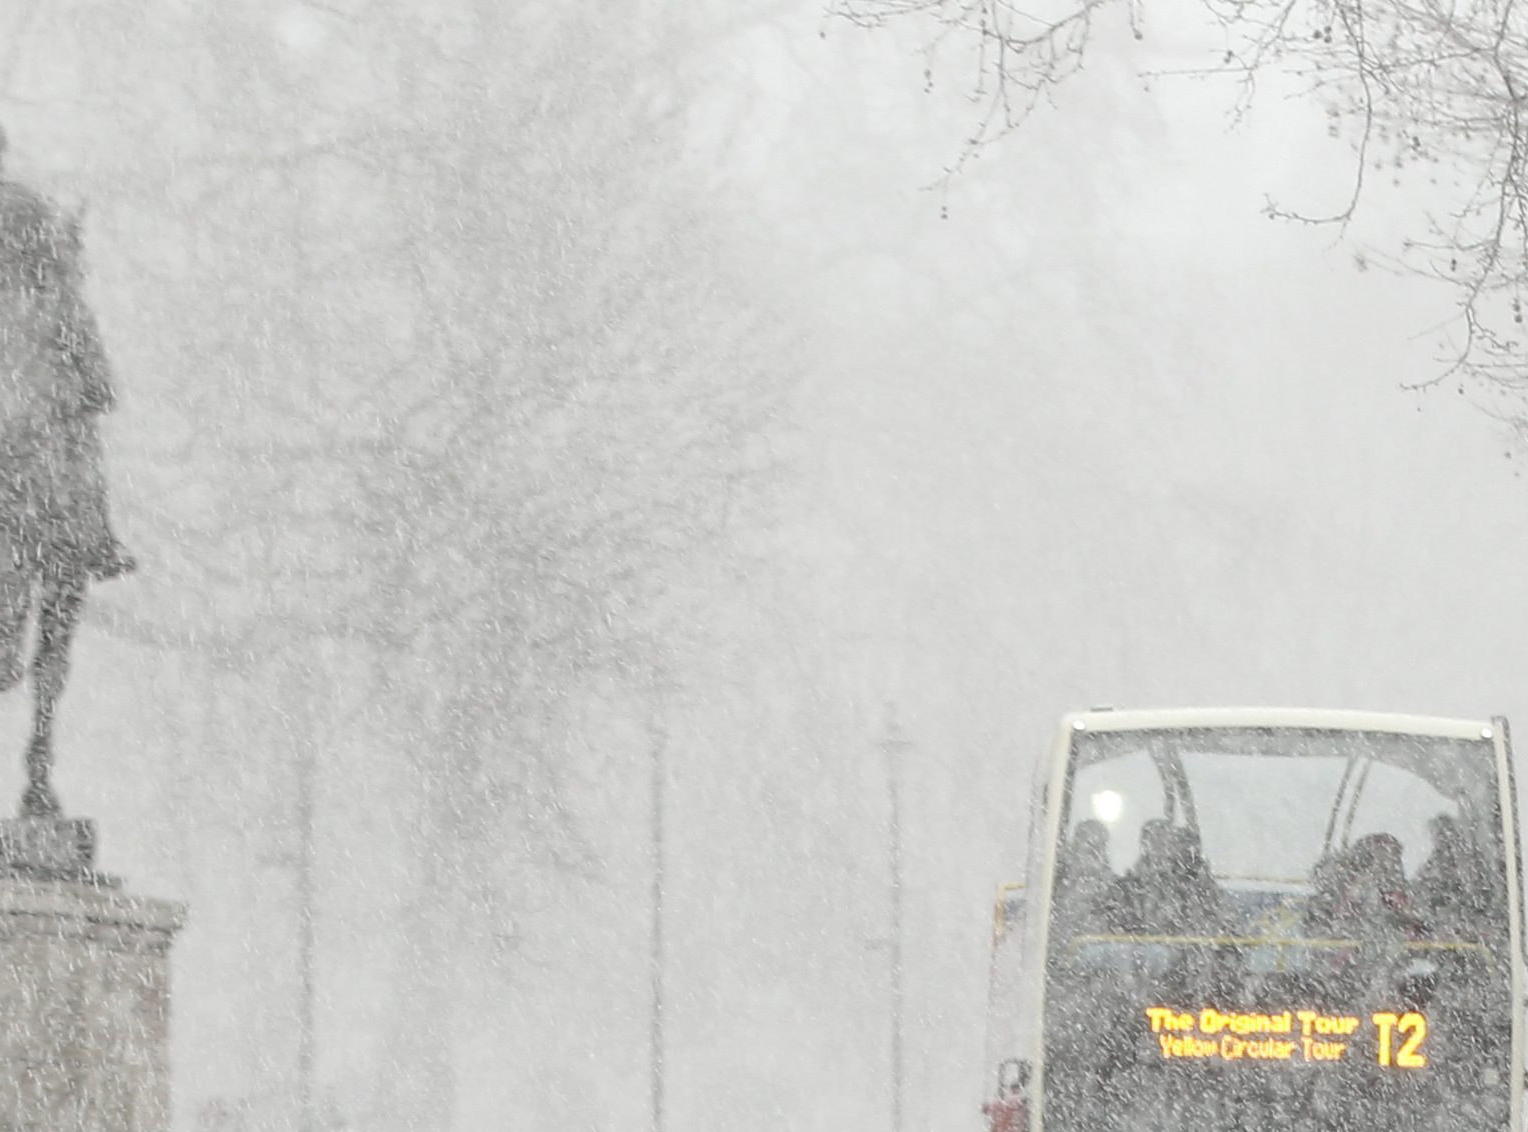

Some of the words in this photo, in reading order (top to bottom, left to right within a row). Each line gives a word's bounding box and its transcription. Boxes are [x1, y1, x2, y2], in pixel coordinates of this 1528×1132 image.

[1145, 1007, 1195, 1033] The
[1199, 1008, 1292, 1034] Original
[1296, 1010, 1360, 1037] Tour
[1159, 1034, 1218, 1058] Yellow
[1221, 1035, 1297, 1060] Circular
[1301, 1036, 1347, 1062] Tour
[1372, 1012, 1427, 1067] T2
